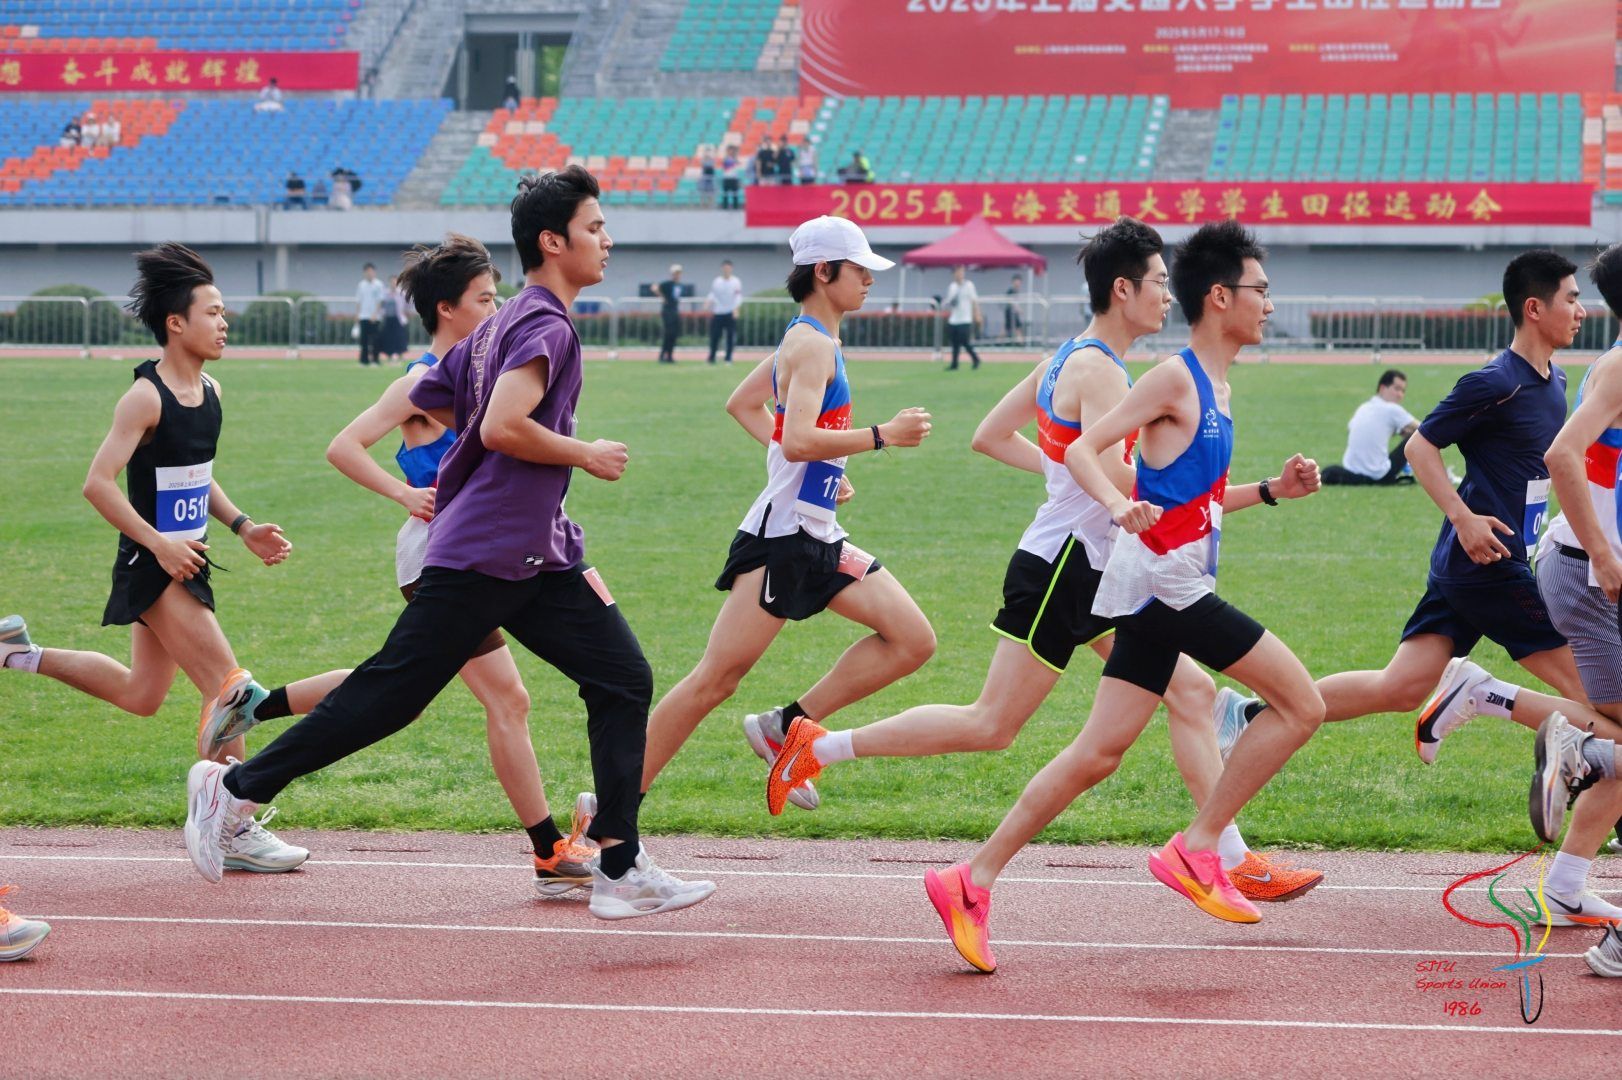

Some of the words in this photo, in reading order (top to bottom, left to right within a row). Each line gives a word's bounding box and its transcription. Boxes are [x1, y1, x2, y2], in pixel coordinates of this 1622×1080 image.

[60, 57, 262, 86] 奋斗成就辉煌
[830, 188, 1503, 223] 2025年上海交通大学学生田径运动会
[1486, 691, 1506, 707] NIKE
